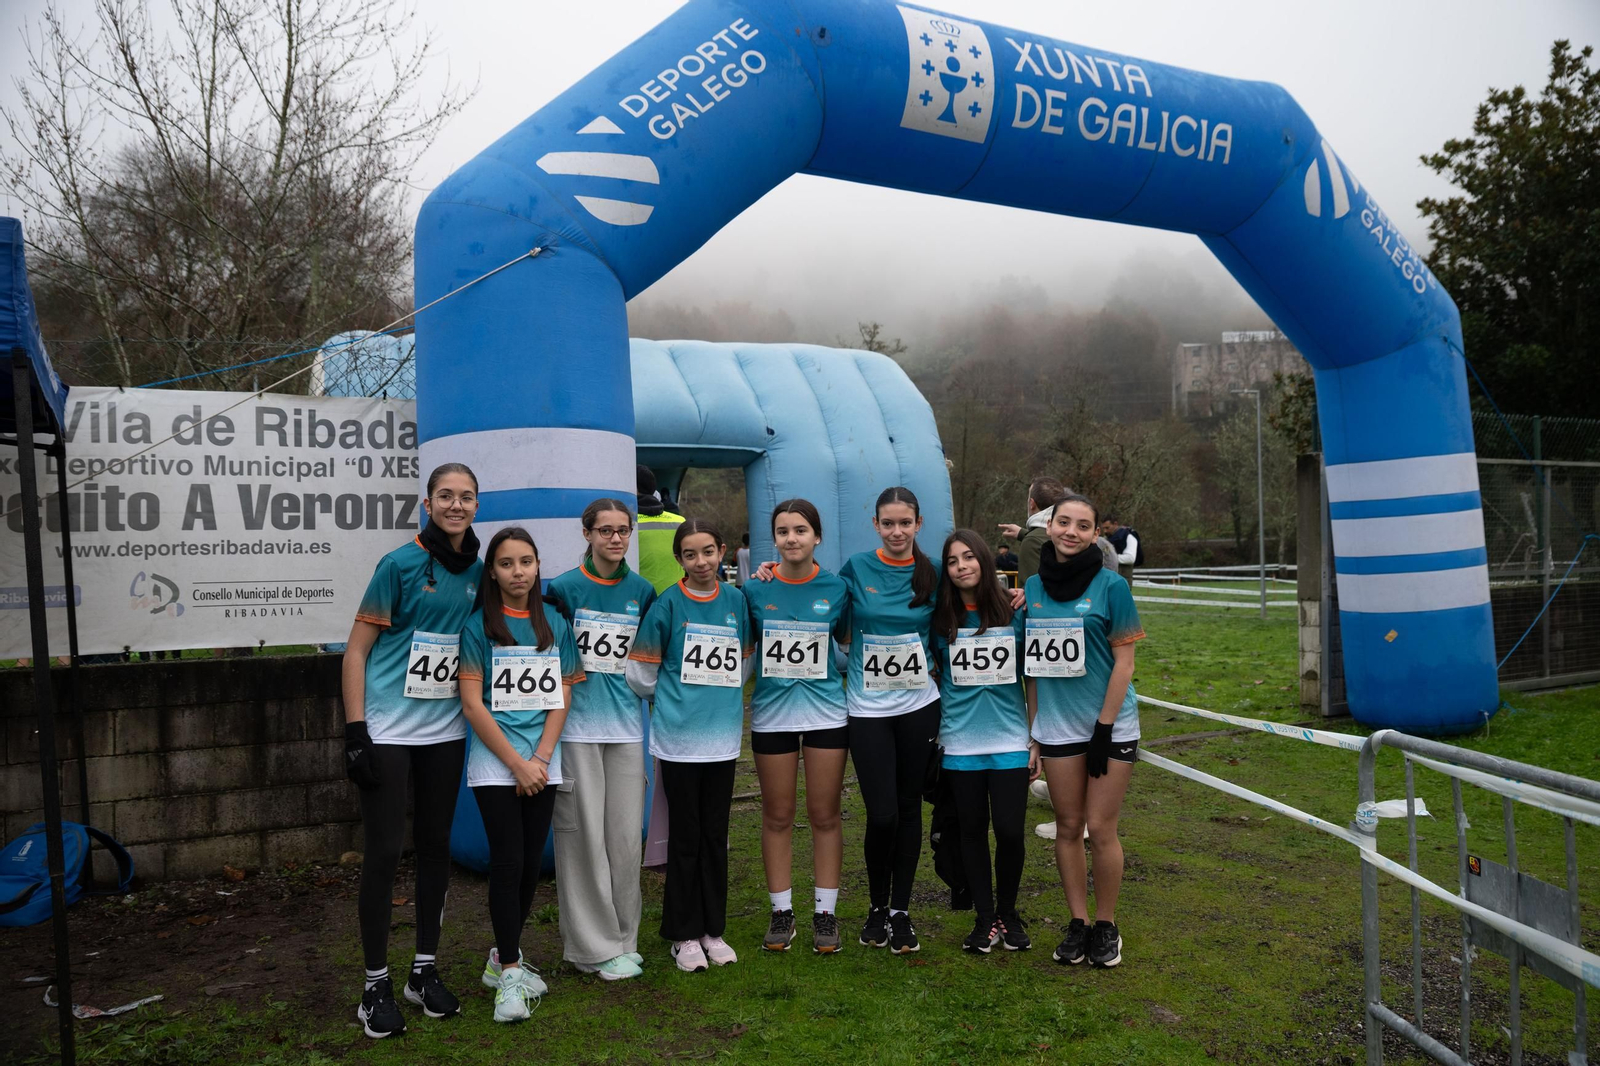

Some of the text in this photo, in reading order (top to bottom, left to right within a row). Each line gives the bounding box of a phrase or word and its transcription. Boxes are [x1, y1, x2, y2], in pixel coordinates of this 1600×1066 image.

[618, 18, 759, 118] DEPORTE
[1004, 37, 1153, 98] XUNTA
[648, 50, 766, 140] GALEGO
[1011, 83, 1232, 165] DE GALICIA
[1360, 209, 1426, 294] GALEGO
[64, 401, 418, 450] Vila de Ribada
[204, 455, 334, 482] Municipal
[0, 483, 418, 533] cuito A Veronz
[55, 539, 331, 560] www.deportesribadavia.es
[193, 586, 334, 602] Consello Municipal de Deportes
[225, 607, 303, 618] RIBADAVIA
[576, 631, 630, 659] 463
[684, 644, 737, 672] 465
[766, 640, 819, 664] 461
[952, 646, 1009, 671] 459
[1026, 638, 1079, 662] 460
[409, 655, 459, 682] 462
[864, 653, 922, 677] 464
[493, 668, 557, 694] 466
